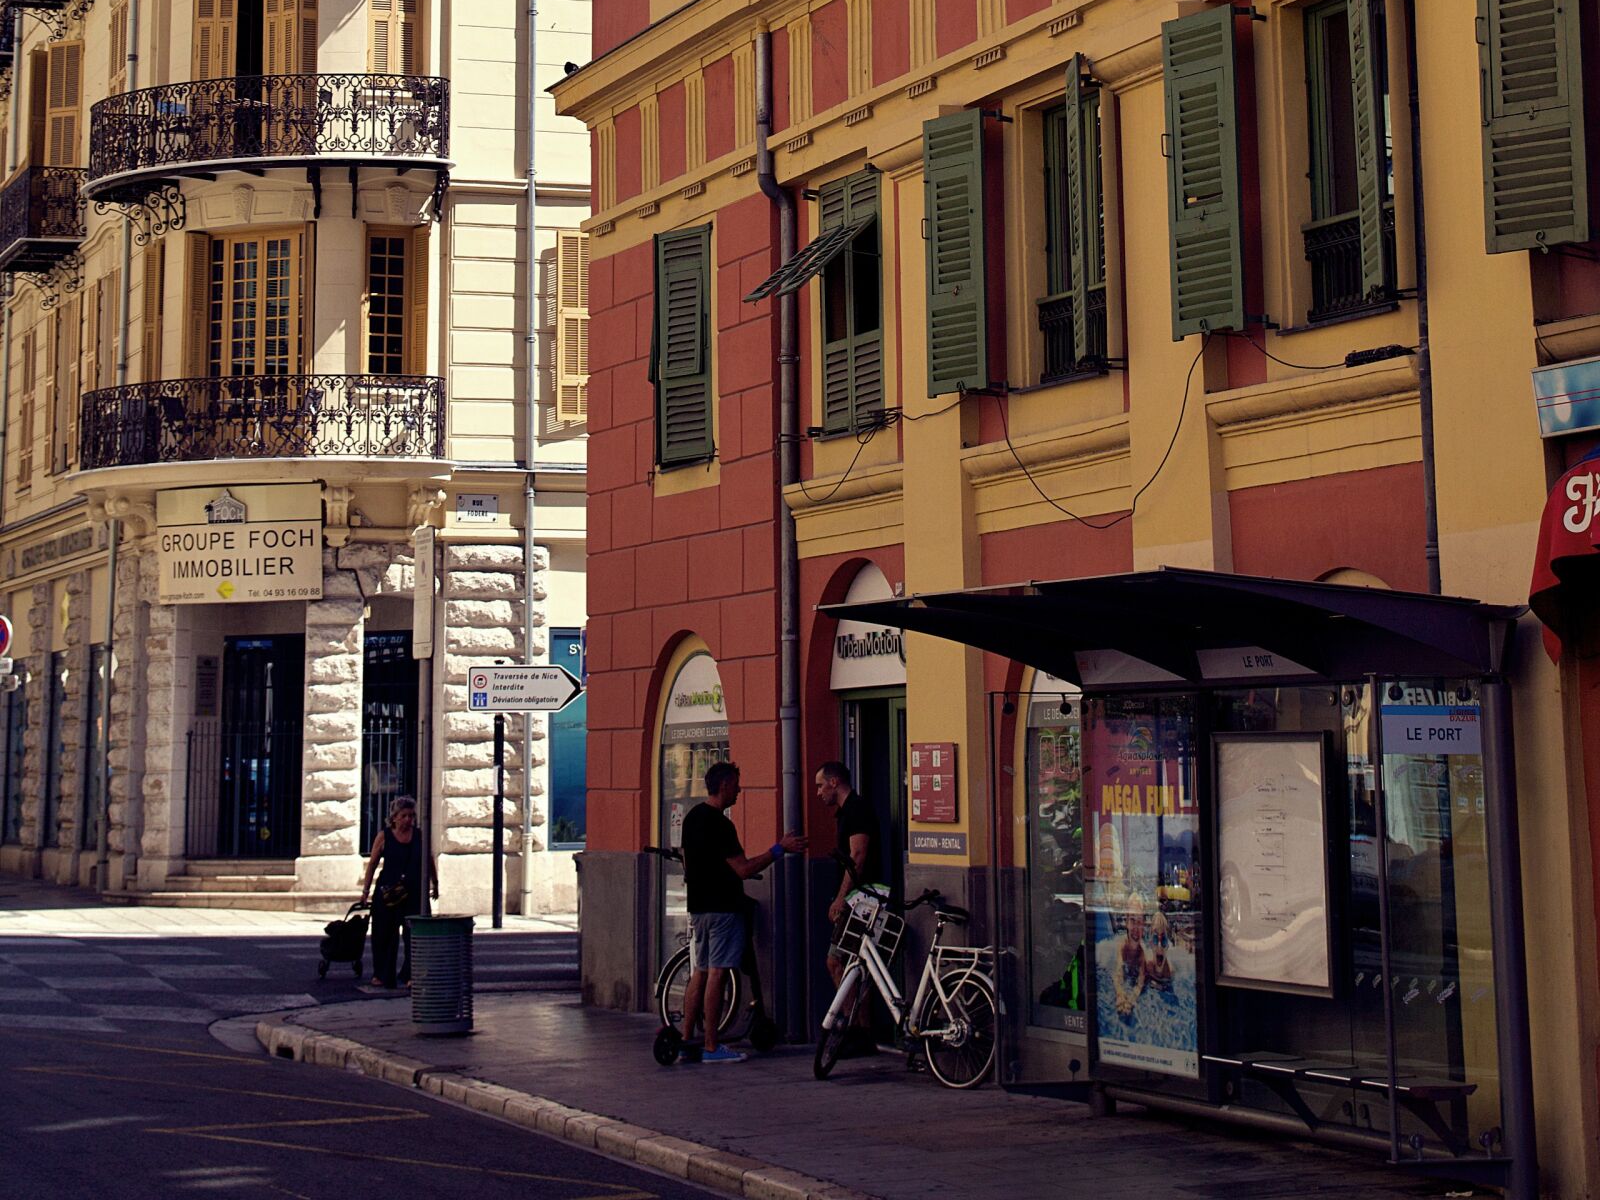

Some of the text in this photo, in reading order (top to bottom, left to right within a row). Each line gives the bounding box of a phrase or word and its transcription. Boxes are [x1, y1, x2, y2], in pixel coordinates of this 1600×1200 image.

[213, 506, 244, 520] FOCH
[161, 528, 314, 553] GROUPE FOCH
[173, 556, 294, 579] IMMOBILIER
[263, 589, 273, 597] 04
[275, 588, 285, 597] 93
[287, 588, 297, 597] 16
[298, 588, 309, 596] 09
[310, 587, 321, 595] 88
[837, 629, 899, 660] UrbanMotion
[1242, 654, 1274, 668] LE PORT
[494, 672, 558, 680] Traversée de Nice
[492, 683, 524, 691] Interdite
[492, 696, 558, 705] Déviation obligatoire
[1406, 727, 1463, 741] LE PORT
[1101, 777, 1142, 816] MÉGA
[1145, 785, 1175, 817] FUN
[914, 836, 938, 849] LOCATION
[941, 838, 961, 850] RENTAL
[1064, 1015, 1085, 1029] VENTE
